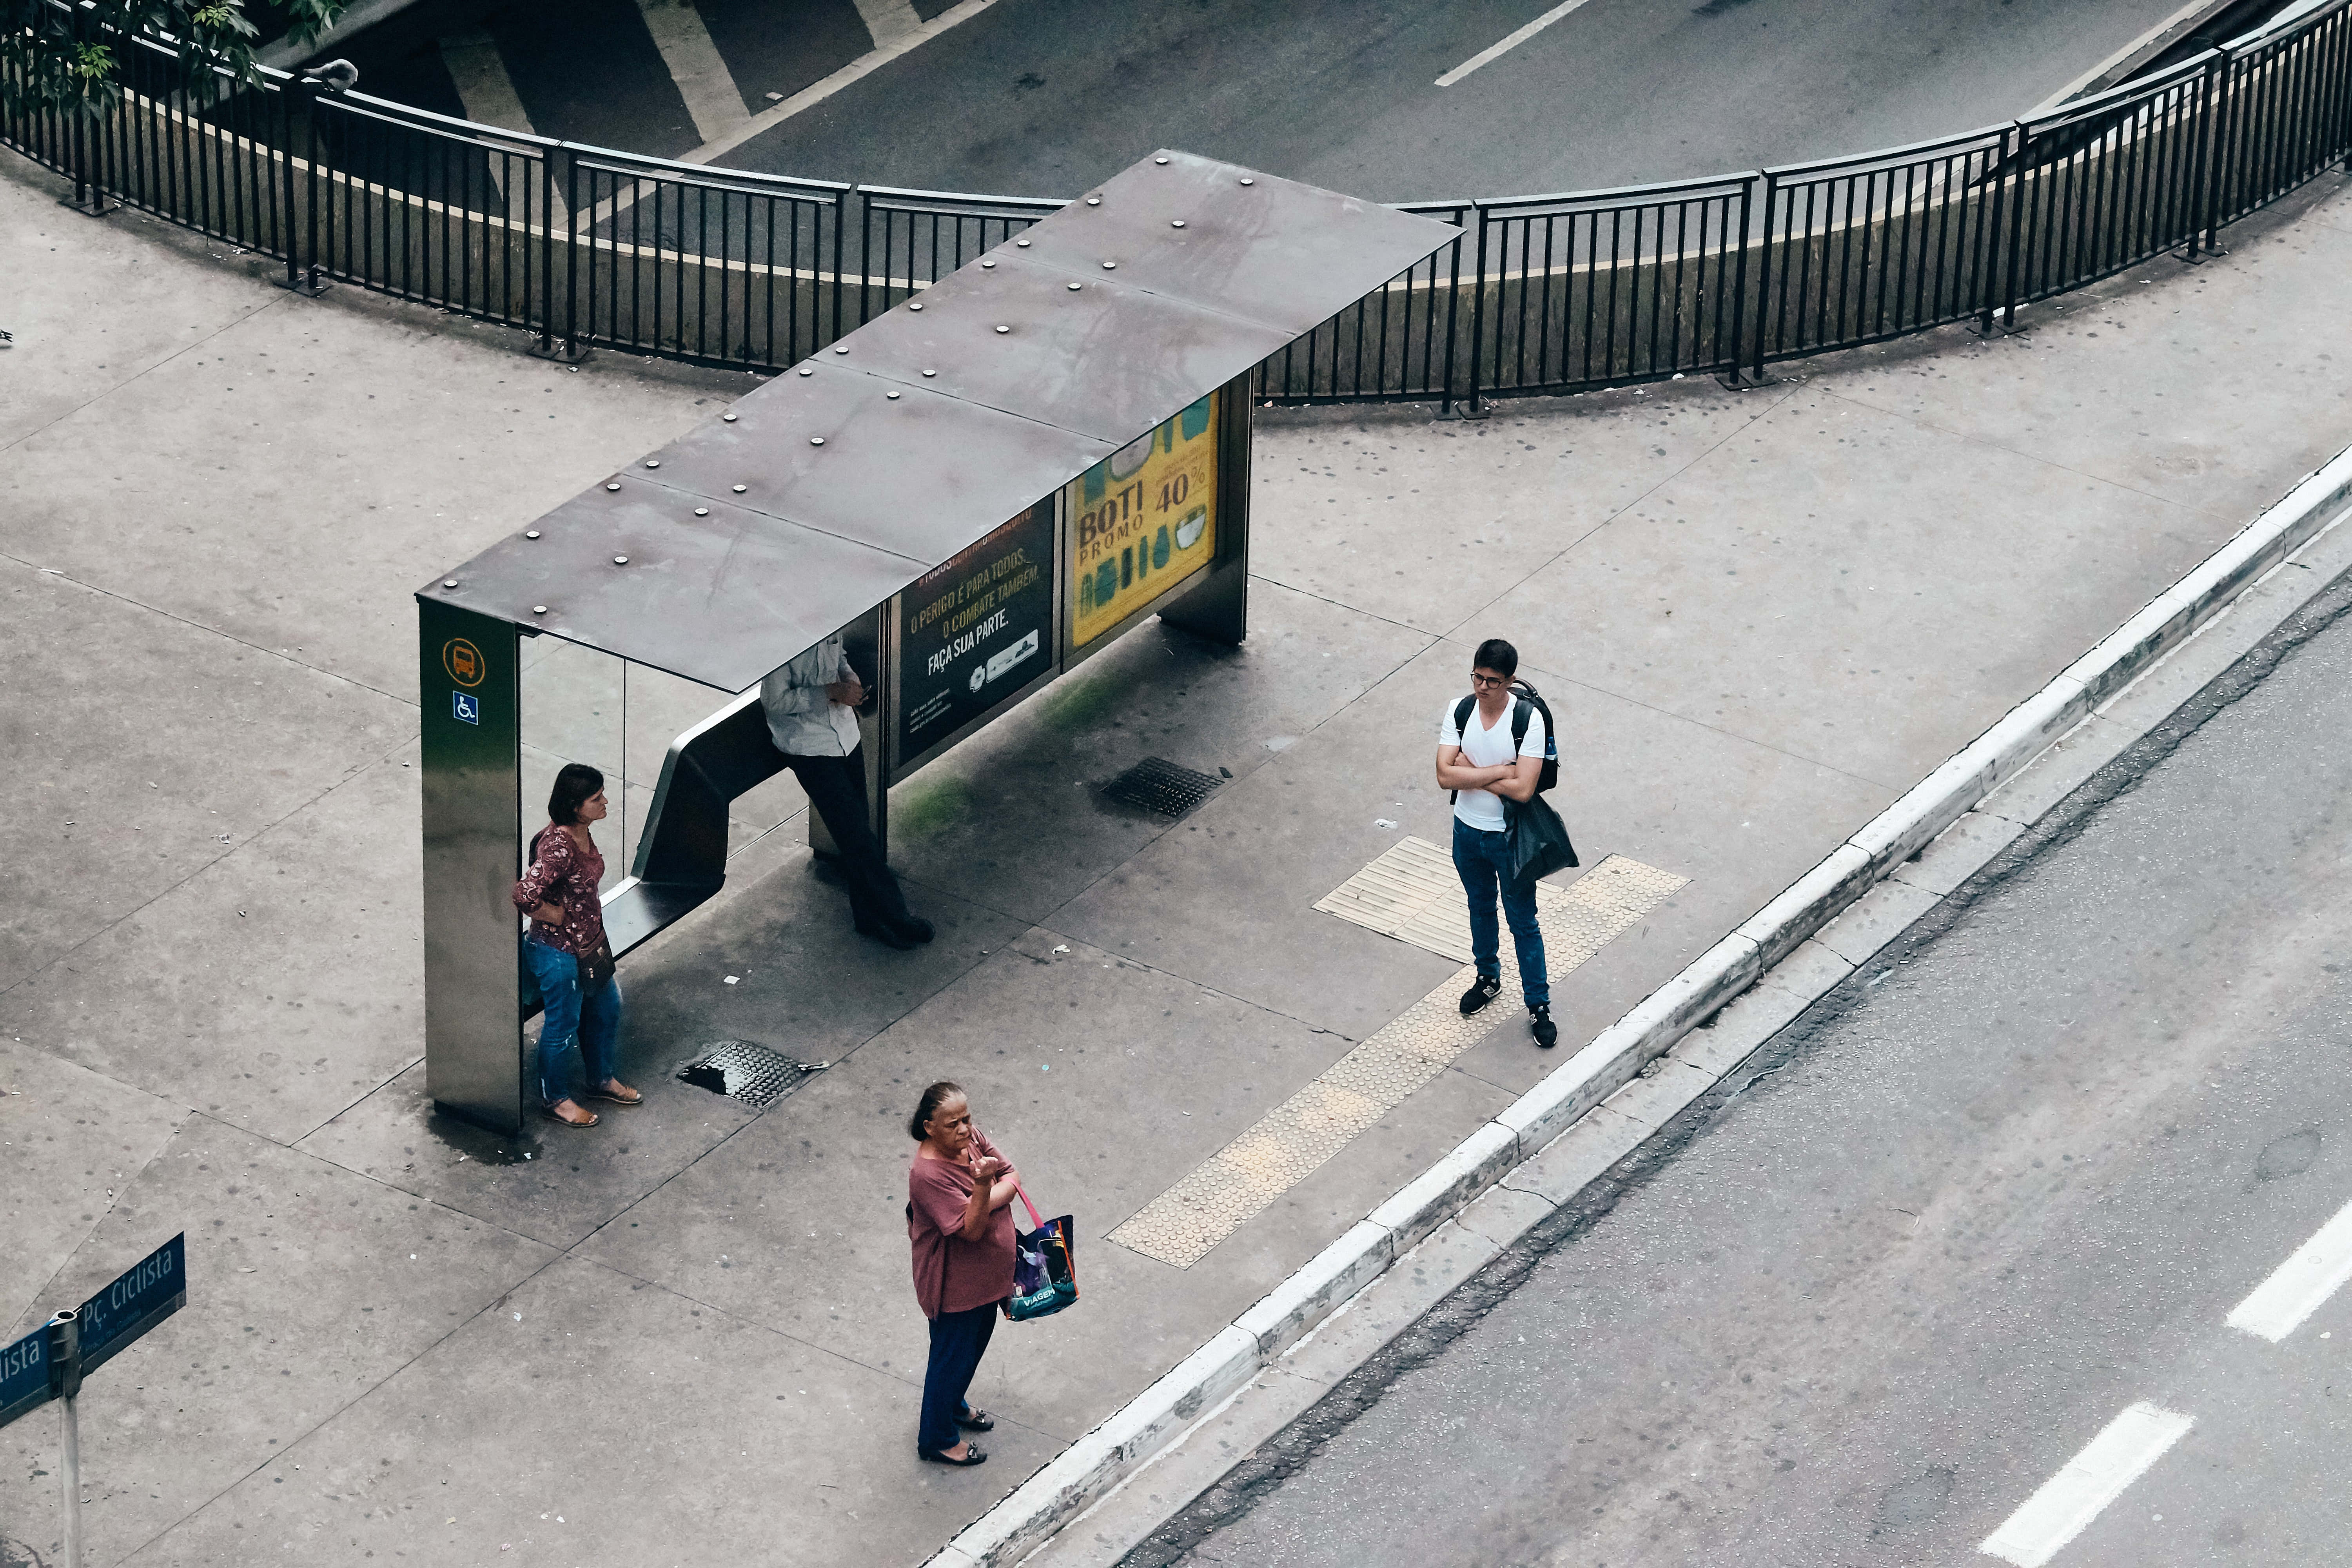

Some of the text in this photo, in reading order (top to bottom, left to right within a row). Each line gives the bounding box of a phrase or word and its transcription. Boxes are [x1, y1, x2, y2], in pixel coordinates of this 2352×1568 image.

[1080, 479, 1143, 549] BOTI
[1080, 514, 1142, 566] PROMO
[911, 616, 917, 633] O
[920, 592, 955, 628] PERIGO
[967, 568, 989, 599] PARA
[943, 620, 949, 639] O
[952, 590, 995, 632] COMBATE
[928, 608, 1009, 676] FAÇA SUA PARTE.
[112, 1250, 172, 1310] Ciclista
[1024, 1287, 1055, 1307] VIAGEM
